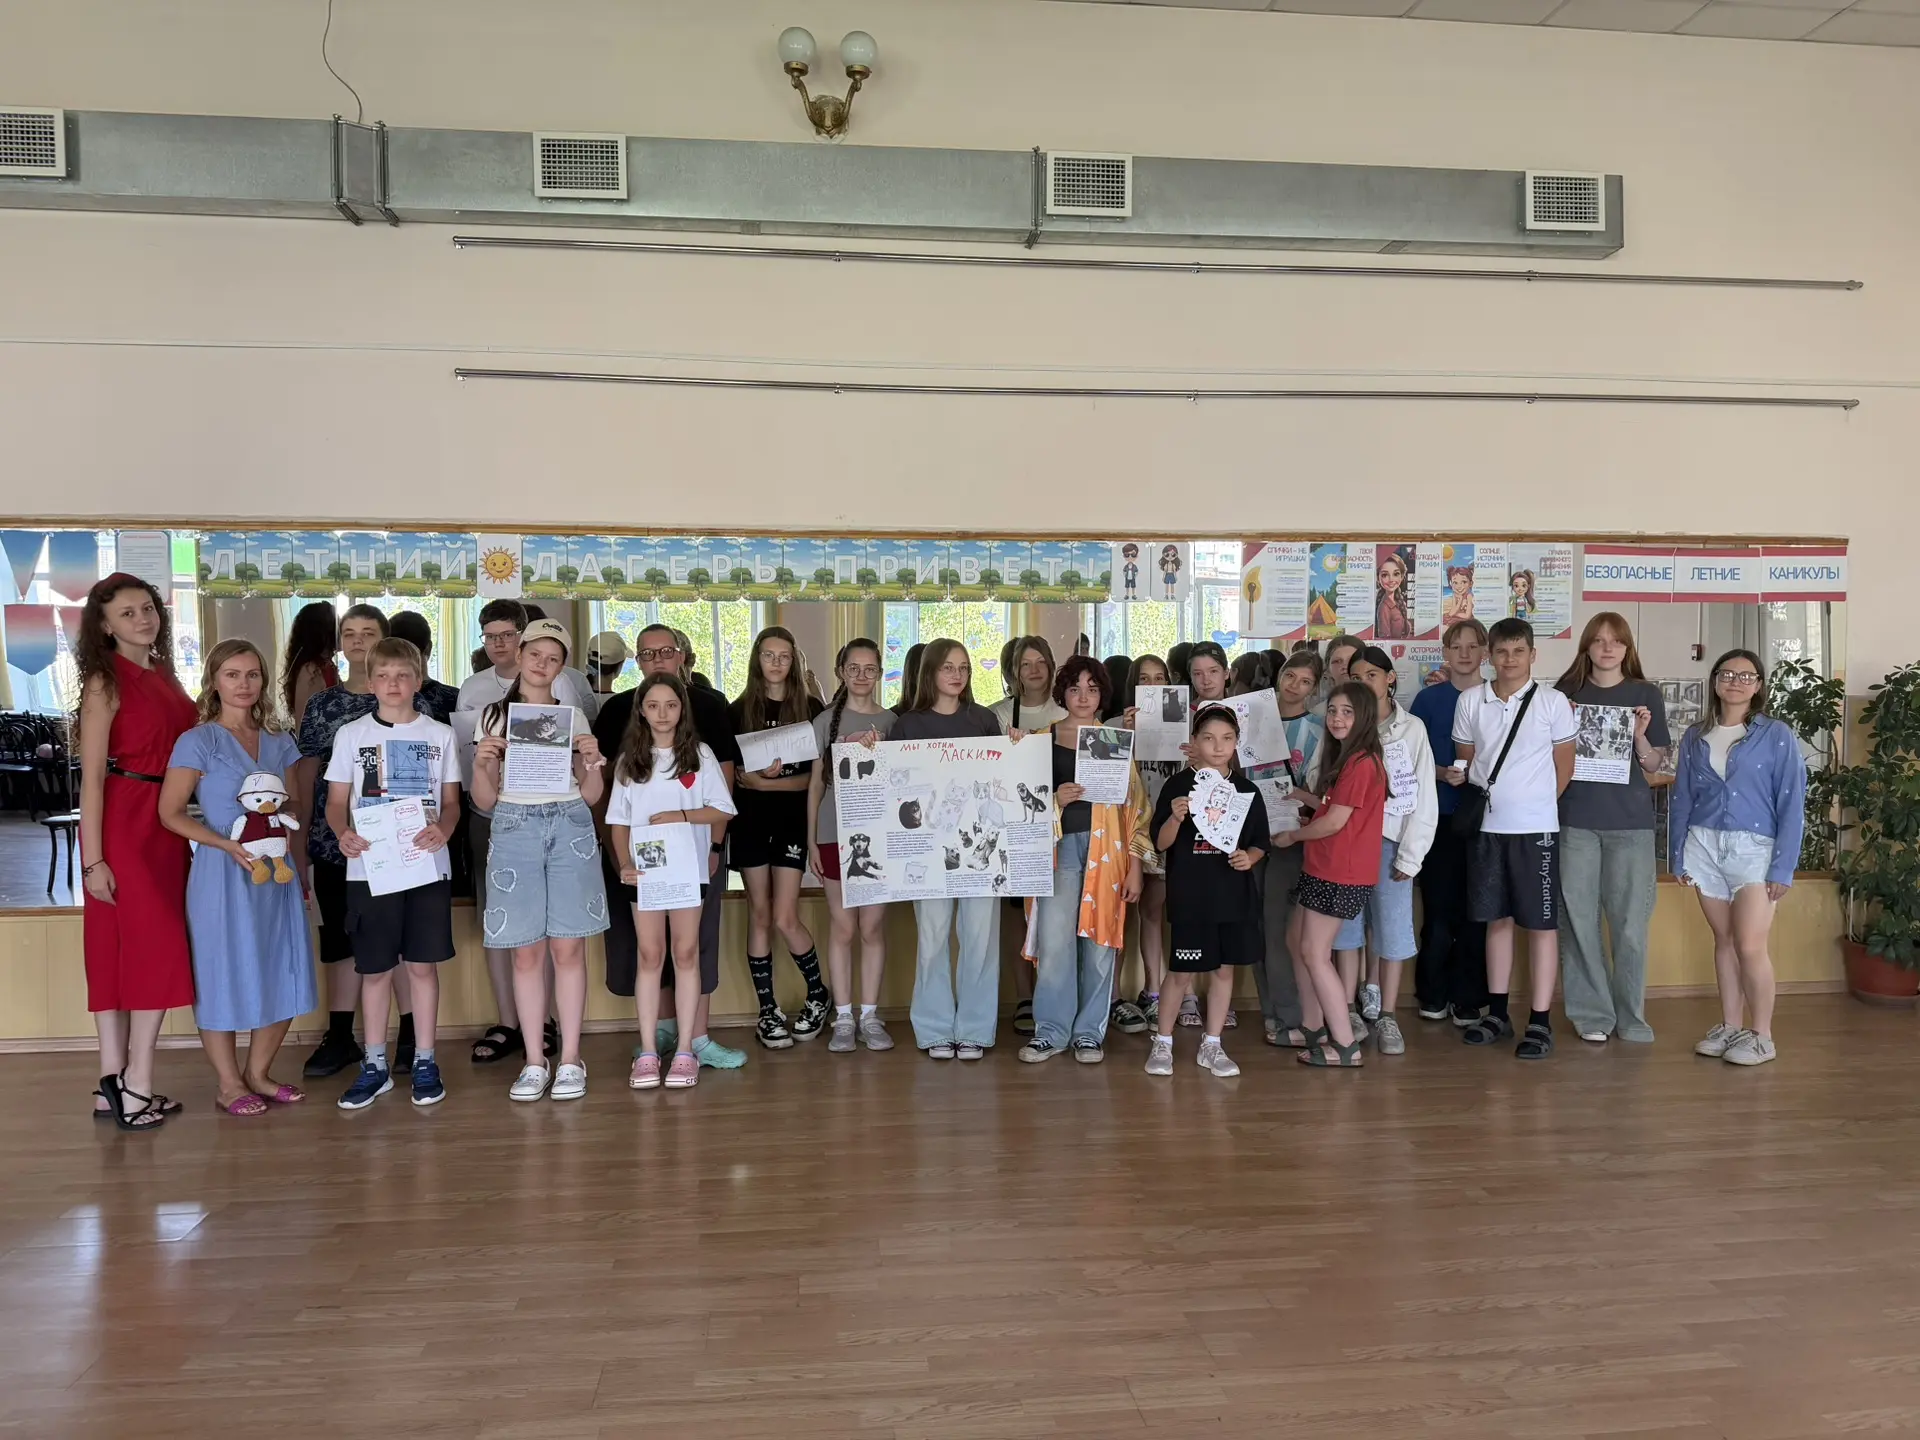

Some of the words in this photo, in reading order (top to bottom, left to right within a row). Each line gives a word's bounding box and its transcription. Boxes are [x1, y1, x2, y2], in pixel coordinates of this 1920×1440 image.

[208, 540, 467, 580] ЛЕТНИЙ
[834, 555, 1095, 588] ПРИВЕТ!
[1585, 565, 1673, 581] БЕЗОПАСНЫЕ
[1690, 567, 1741, 581] ЛЕТНИЕ
[1769, 566, 1840, 580] КАНИКУЛЫ
[408, 744, 441, 753] ANCHOR
[416, 752, 441, 761] POINT
[1539, 851, 1553, 919] PlayStation
